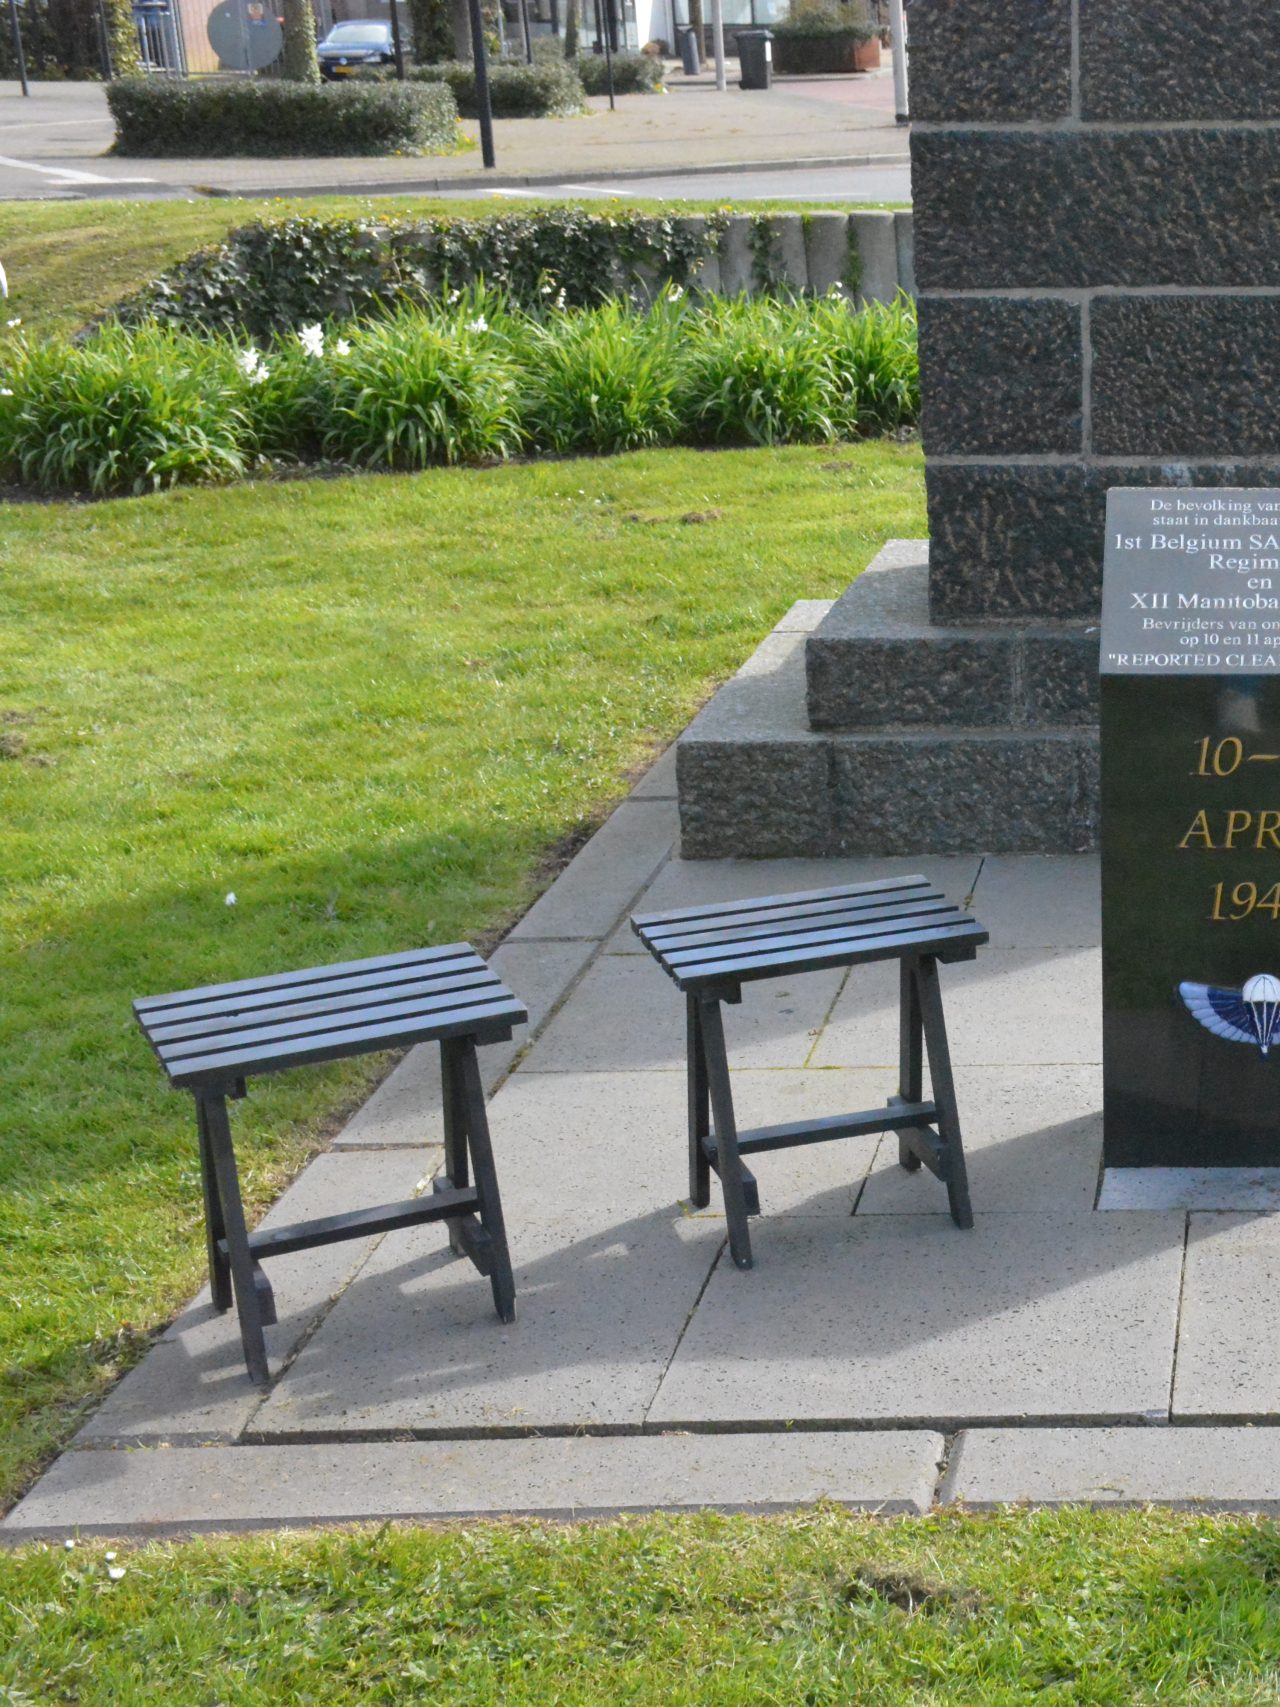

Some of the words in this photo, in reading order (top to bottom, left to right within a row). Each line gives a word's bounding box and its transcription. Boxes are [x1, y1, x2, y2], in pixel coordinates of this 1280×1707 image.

[1151, 500, 1172, 511] De
[1177, 500, 1252, 513] bevolking
[1153, 516, 1189, 526] staat
[1194, 515, 1208, 526] in
[1114, 534, 1142, 550] 1st
[1151, 534, 1242, 553] Belgium
[1247, 577, 1272, 589] en
[1129, 593, 1169, 609] XII
[1178, 593, 1279, 609] Manitoba
[1142, 618, 1224, 632] Bevrijders
[1229, 621, 1257, 630] van
[1180, 635, 1199, 647] op
[1204, 634, 1219, 645] 10
[1223, 635, 1241, 645] en
[1247, 634, 1259, 645] 11
[1108, 653, 1220, 666] "REPORTED
